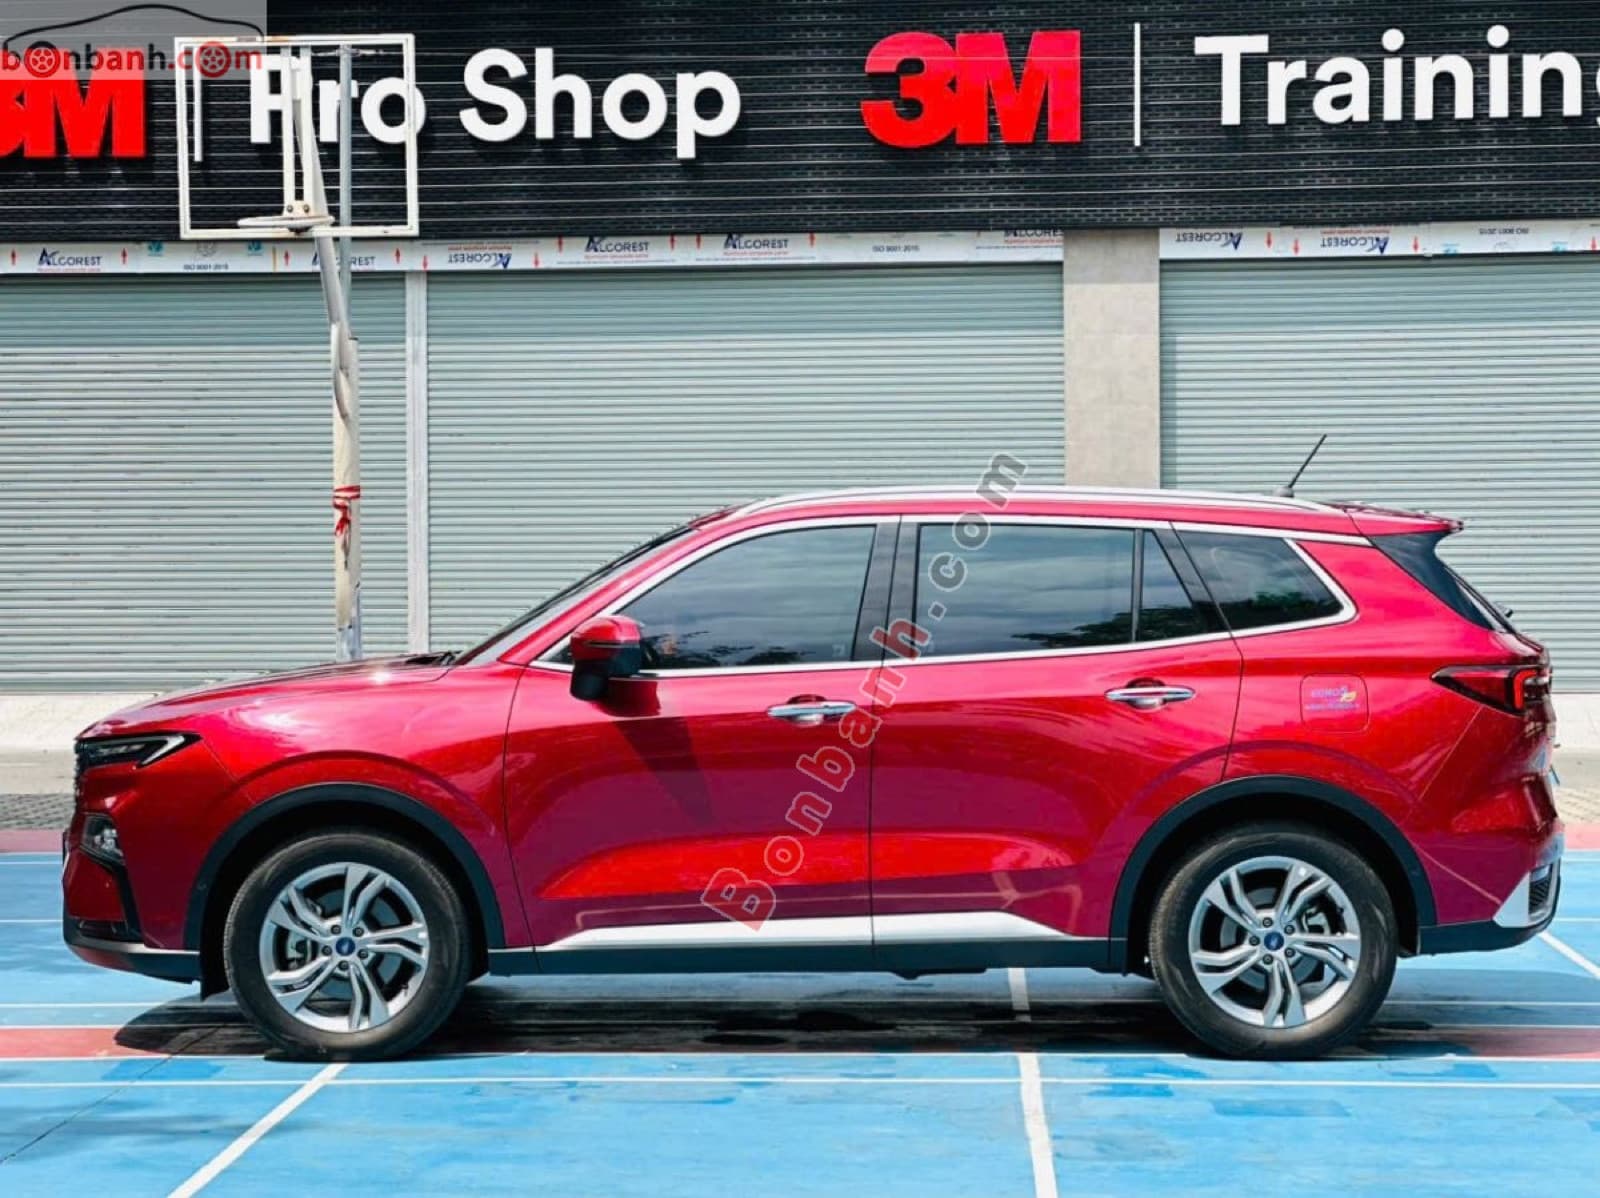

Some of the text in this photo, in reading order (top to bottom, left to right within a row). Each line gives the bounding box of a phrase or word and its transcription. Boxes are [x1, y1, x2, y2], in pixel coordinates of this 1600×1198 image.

[250, 53, 427, 144] Pro
[459, 47, 742, 160] Shop
[861, 25, 1600, 148] 3M Trainin
